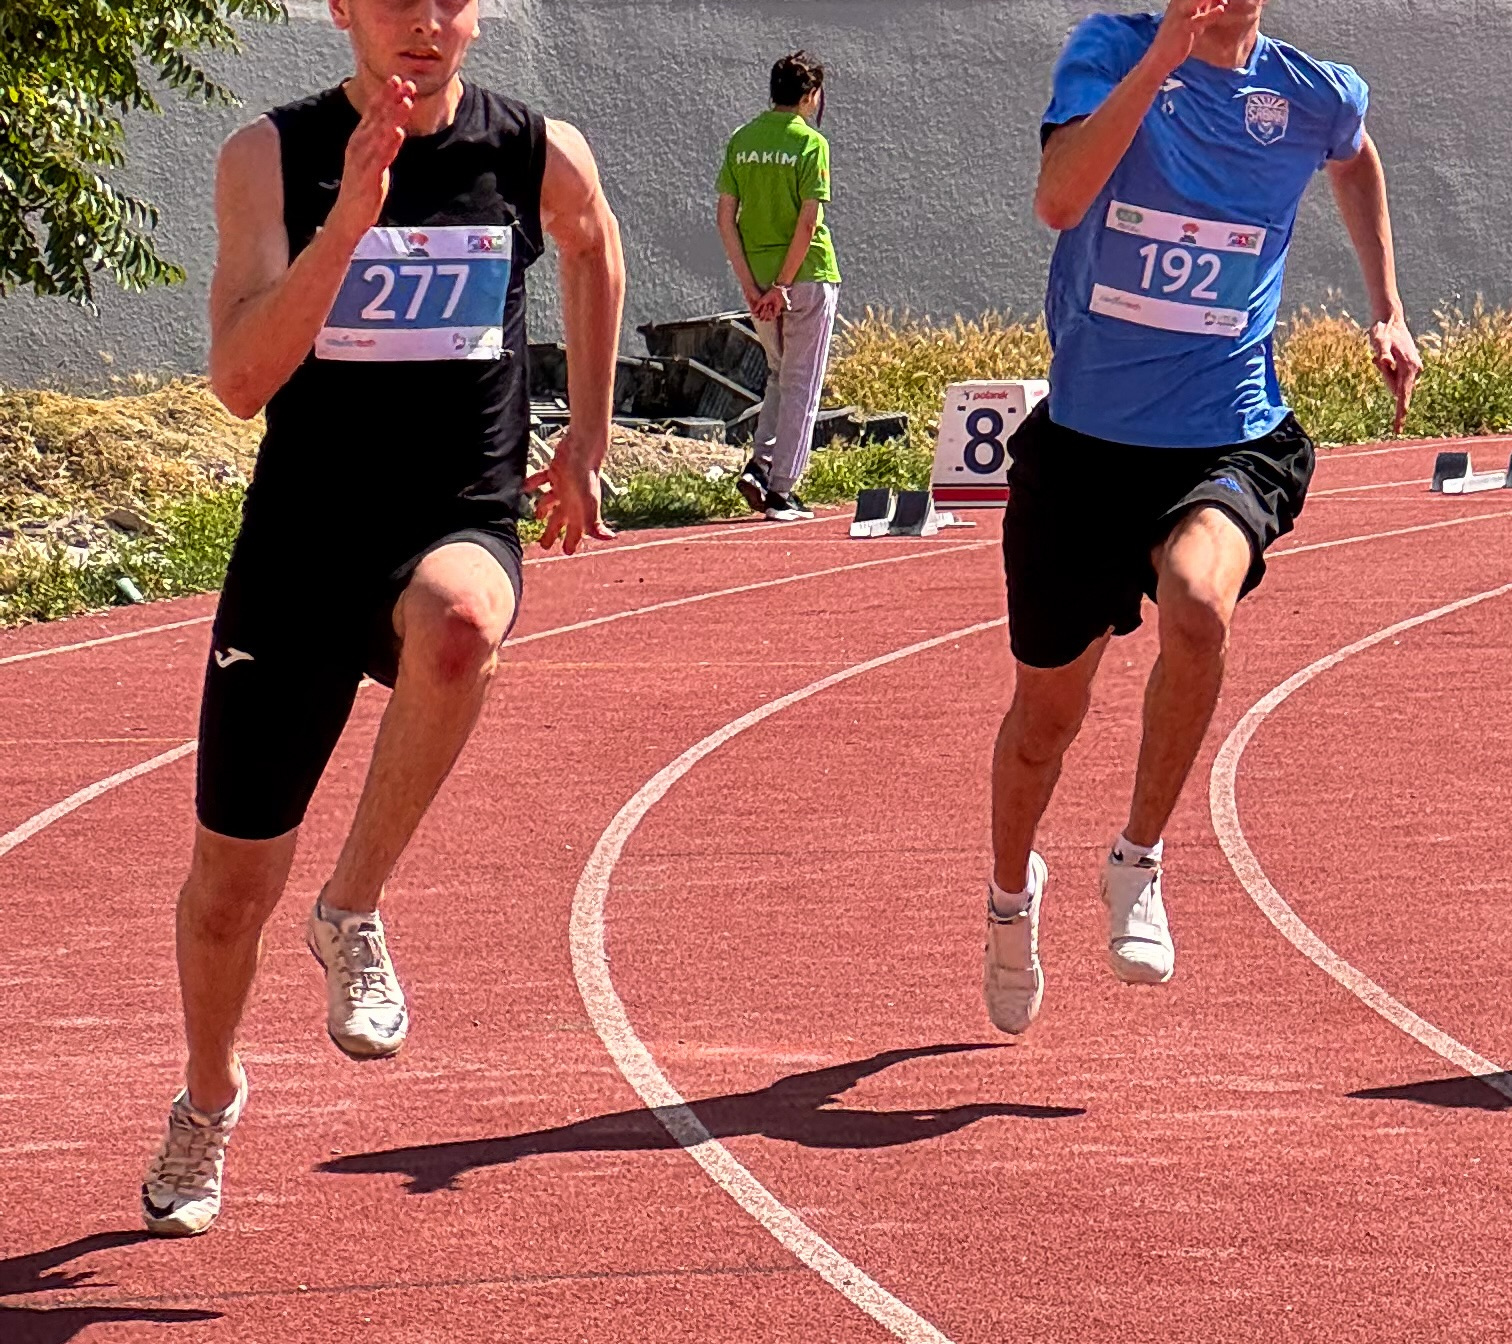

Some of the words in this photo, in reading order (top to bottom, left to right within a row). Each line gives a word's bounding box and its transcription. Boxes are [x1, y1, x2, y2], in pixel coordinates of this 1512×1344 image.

[361, 264, 470, 320] 277
[1139, 243, 1221, 300] 192
[964, 407, 1005, 474] 8
